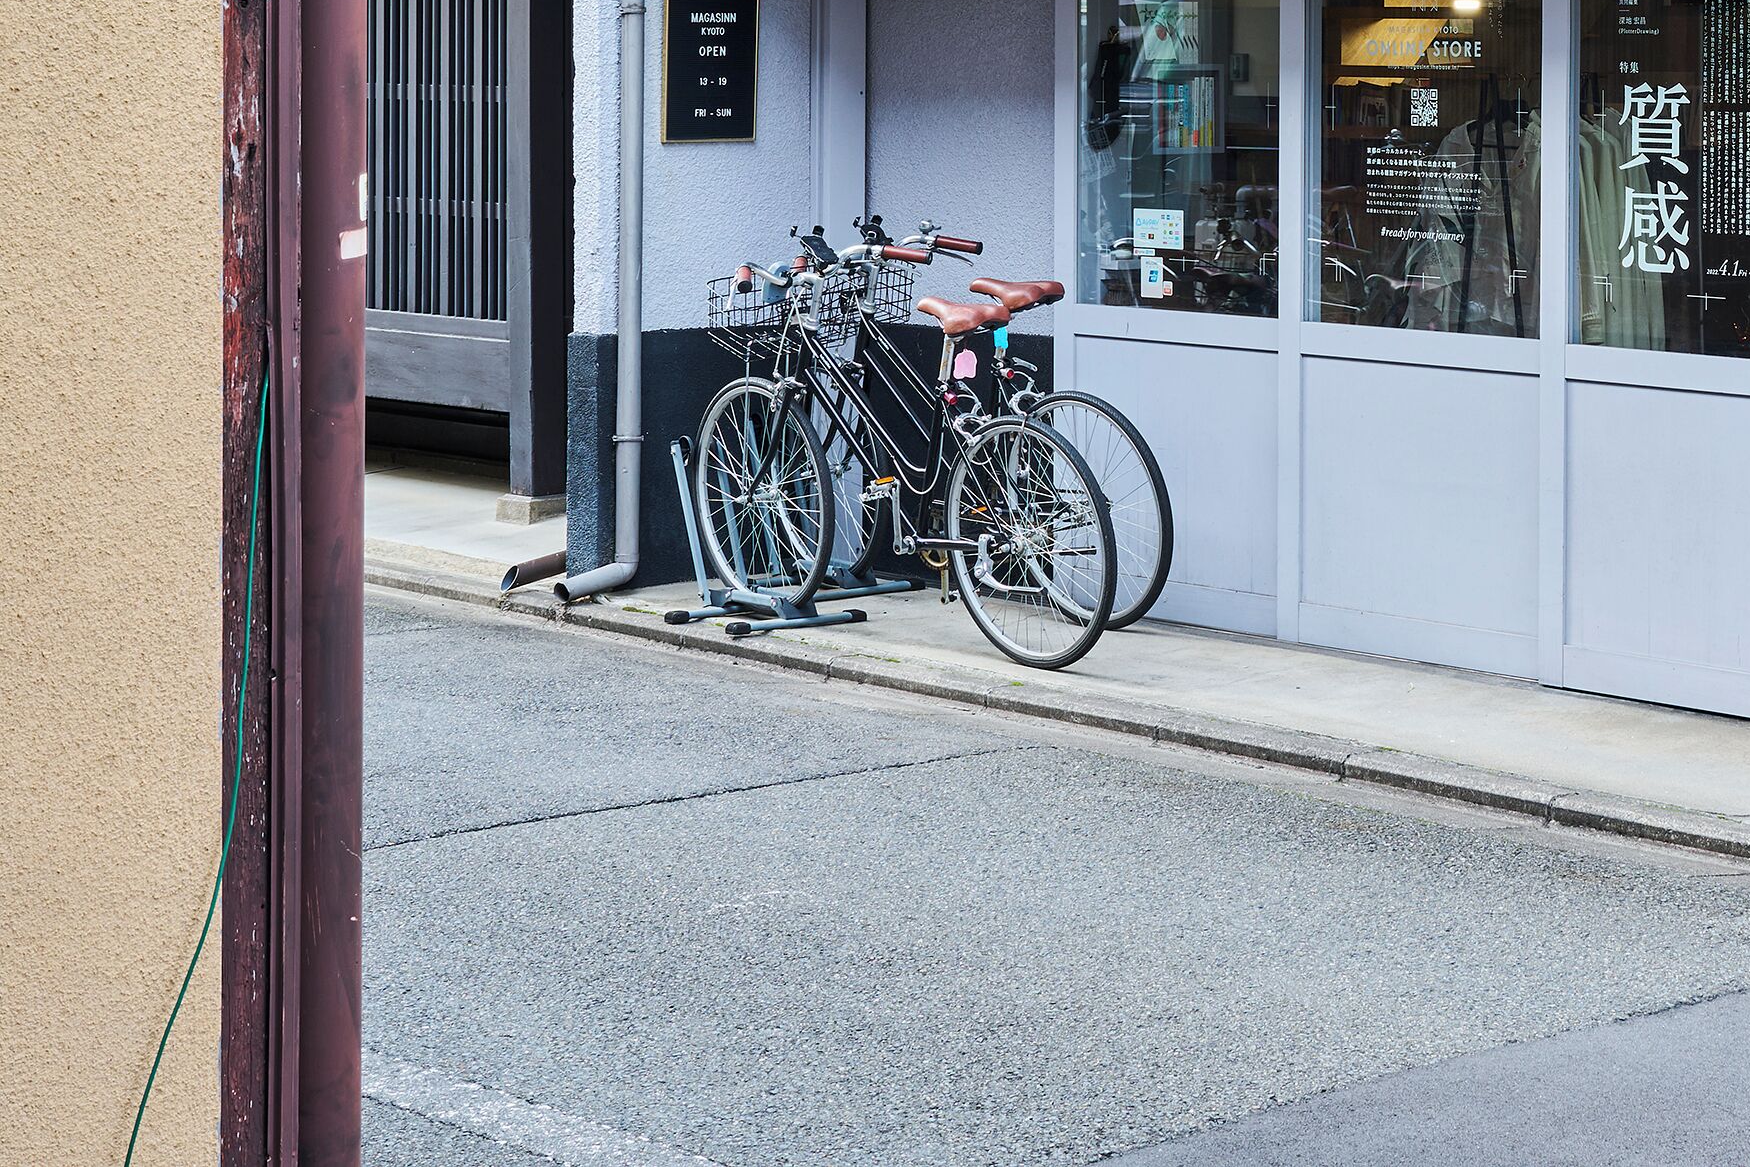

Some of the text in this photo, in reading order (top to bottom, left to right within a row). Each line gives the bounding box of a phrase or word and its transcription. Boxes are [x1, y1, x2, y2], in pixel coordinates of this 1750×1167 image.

[691, 12, 737, 24] MAGASINN
[701, 27, 725, 36] KYOTO
[699, 46, 727, 57] OPEN
[1366, 39, 1482, 58] ONLINE STORE
[1619, 61, 1639, 74] 特集
[699, 77, 708, 86] 13
[718, 77, 727, 86] 19
[694, 109, 706, 117] FRI
[716, 108, 732, 117] SUN
[1618, 81, 1691, 274] 質感
[1380, 227, 1465, 243] #readyforyourjourney
